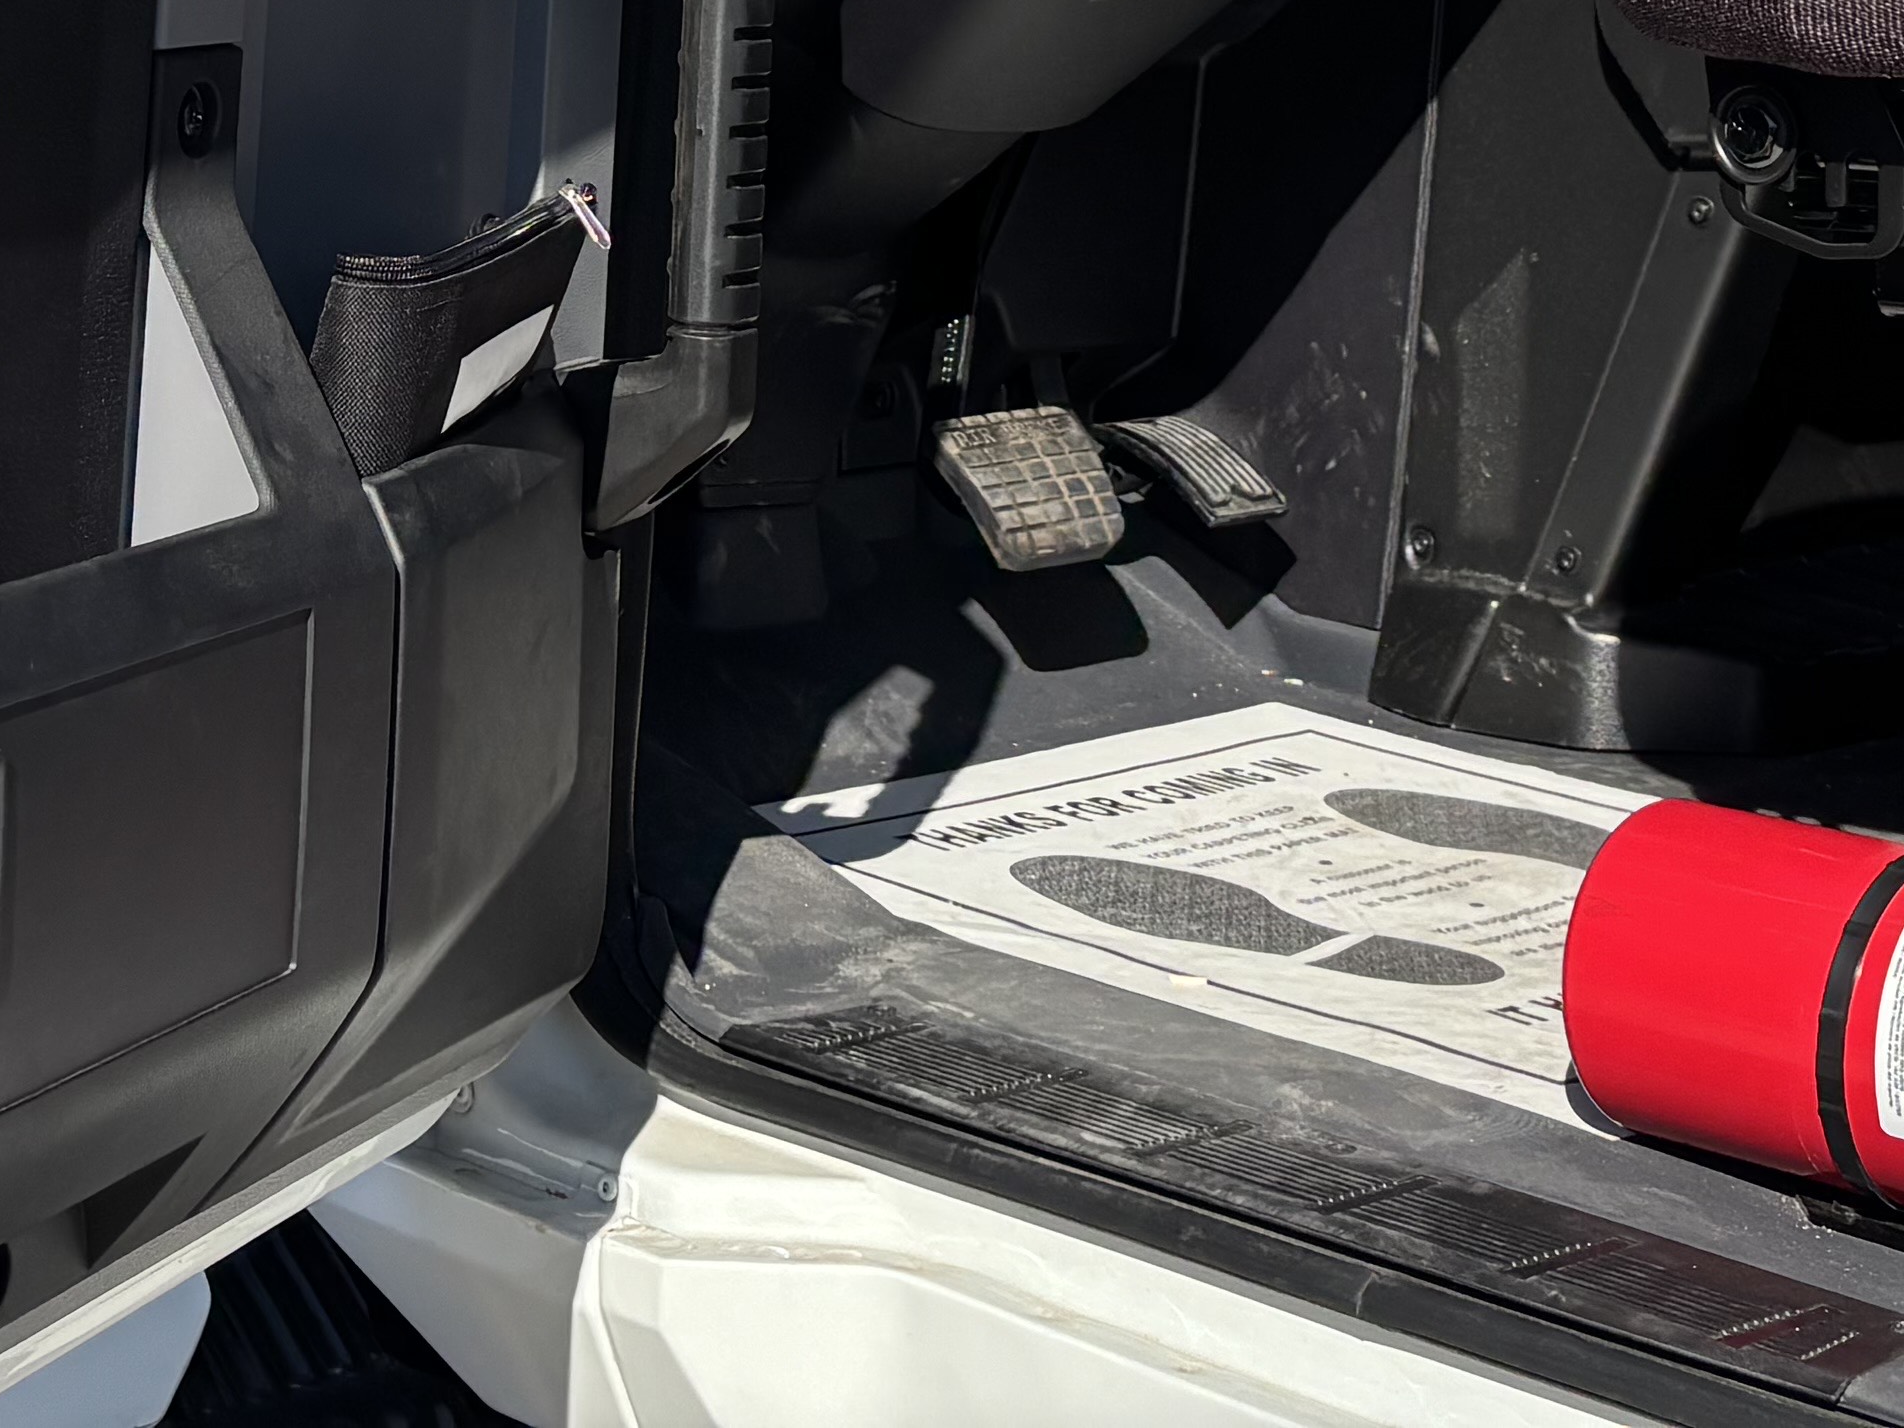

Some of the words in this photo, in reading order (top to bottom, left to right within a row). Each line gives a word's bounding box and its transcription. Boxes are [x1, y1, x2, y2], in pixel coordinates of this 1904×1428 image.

[895, 805, 1059, 851] THANKS
[1049, 795, 1148, 823] FOR
[1121, 765, 1279, 805] COMING
[1248, 756, 1323, 777] IN
